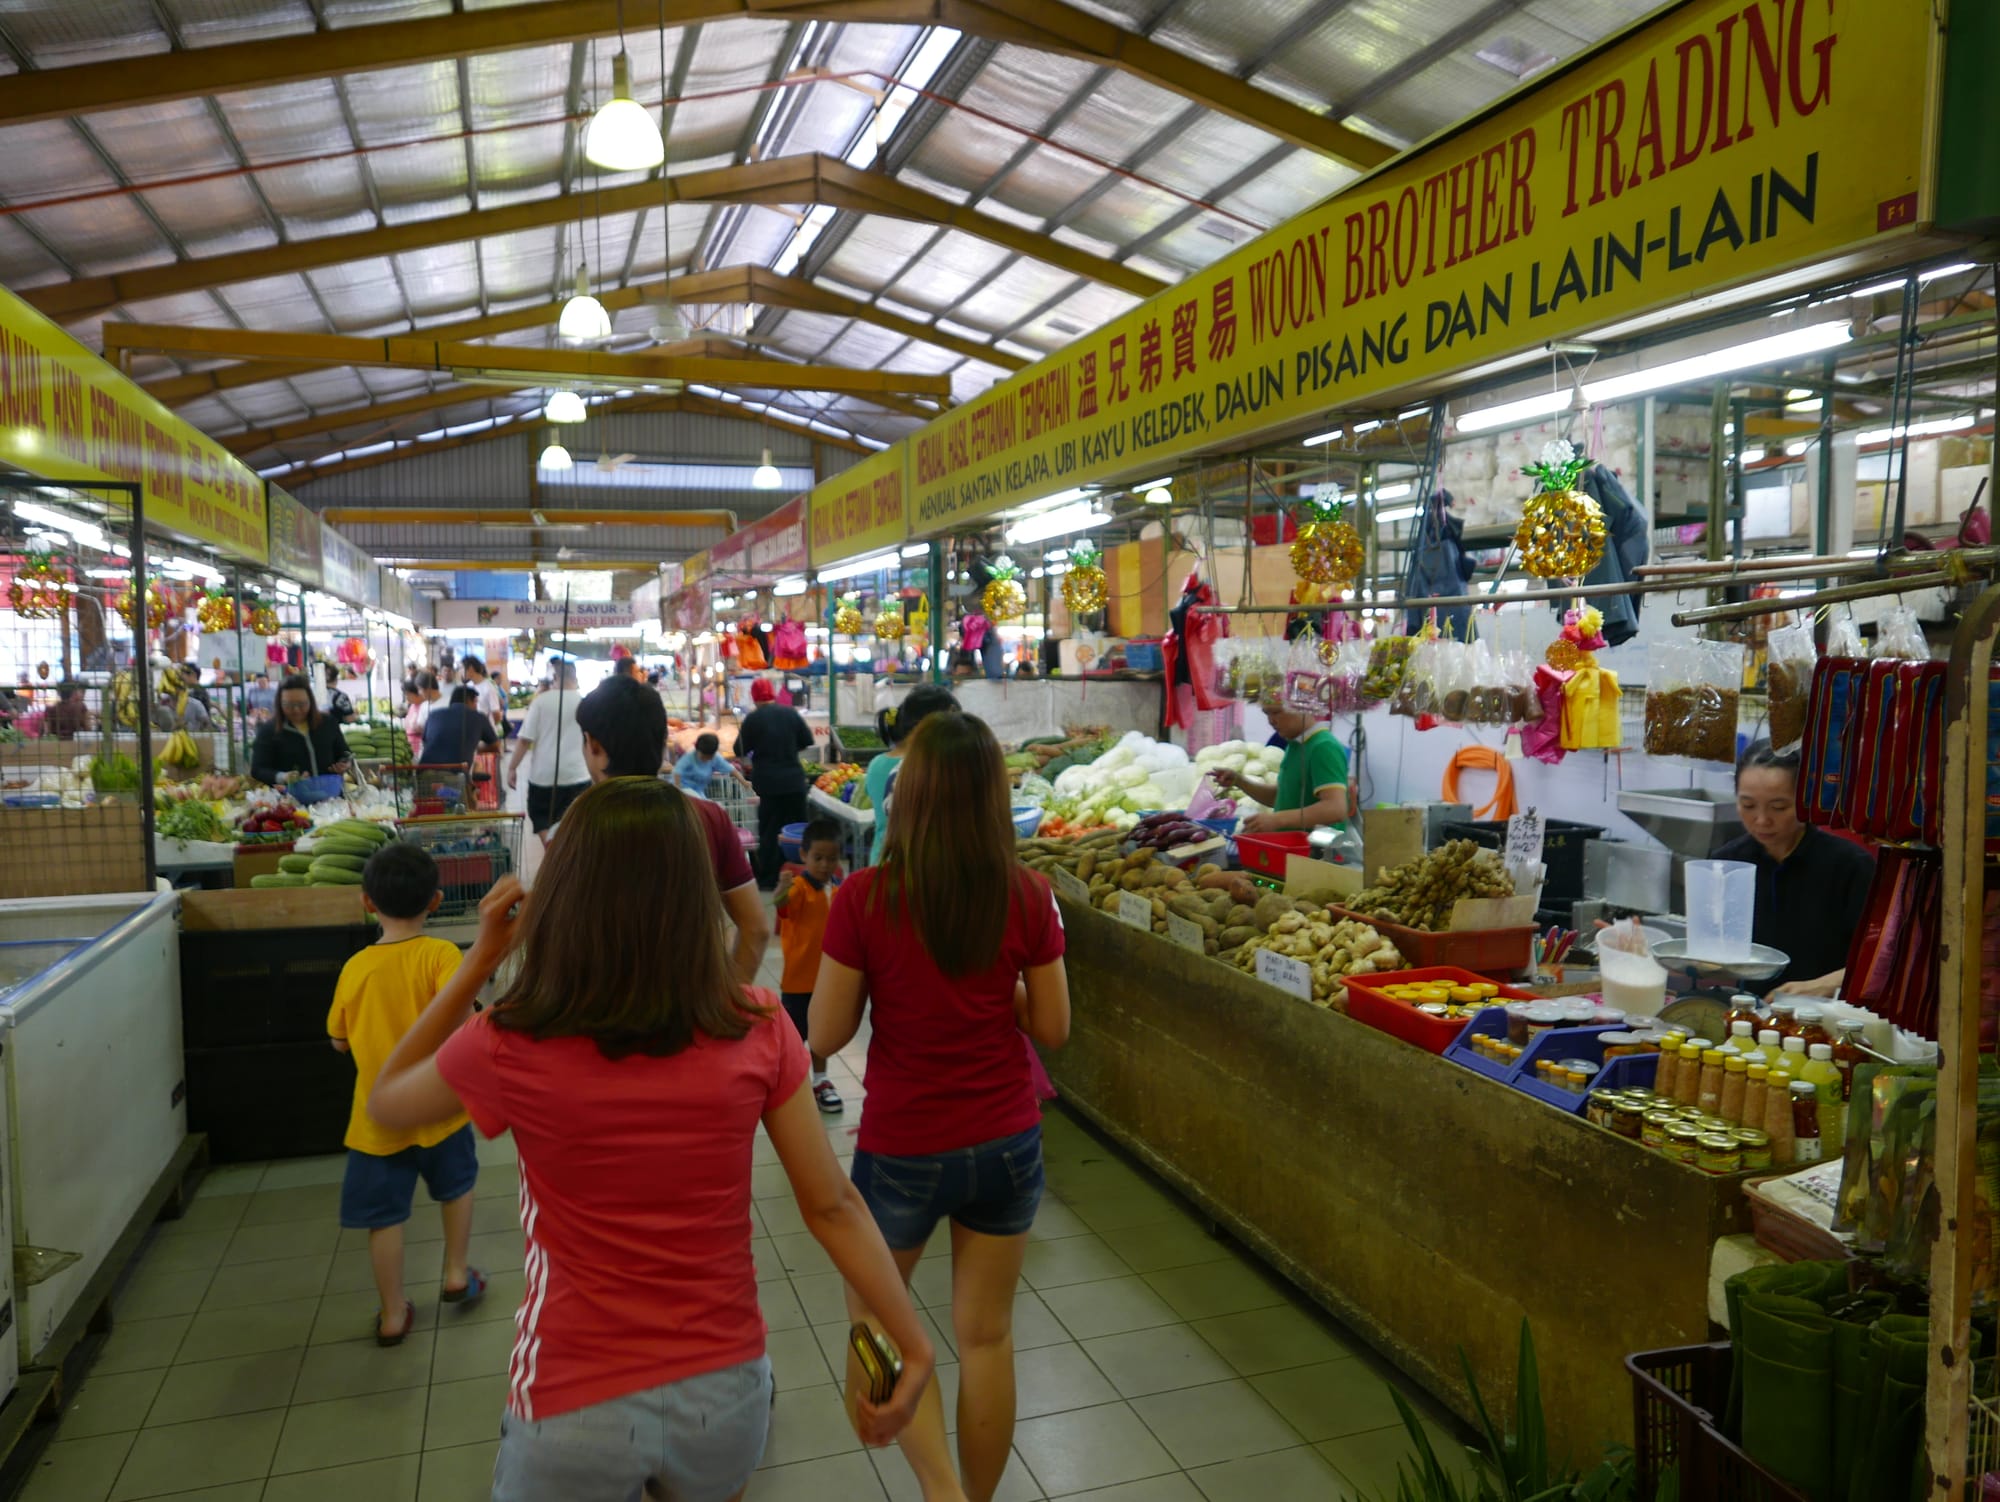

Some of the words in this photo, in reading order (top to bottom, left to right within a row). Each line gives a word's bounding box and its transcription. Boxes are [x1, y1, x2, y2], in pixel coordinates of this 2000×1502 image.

[1248, 226, 1330, 346] WOON
[1342, 126, 1537, 309] BROTHER
[1560, 0, 1838, 219] TRADING
[960, 468, 1002, 508] SANTAN
[1055, 438, 1077, 477] UBI
[1082, 420, 1126, 469] KAYU
[1132, 389, 1211, 452] KELEDEK,
[1215, 357, 1285, 424] DAUN
[1296, 311, 1409, 397] PISANG
[1424, 270, 1513, 354] DAN
[1529, 151, 1821, 319] LAIN-LAIN
[0, 323, 46, 434] NJUAL
[51, 357, 87, 465] HASIL
[1020, 362, 1071, 442] TEMPATAN
[514, 604, 574, 614] MENJUAL
[577, 604, 617, 614] SAYUR
[569, 616, 596, 626] RESH
